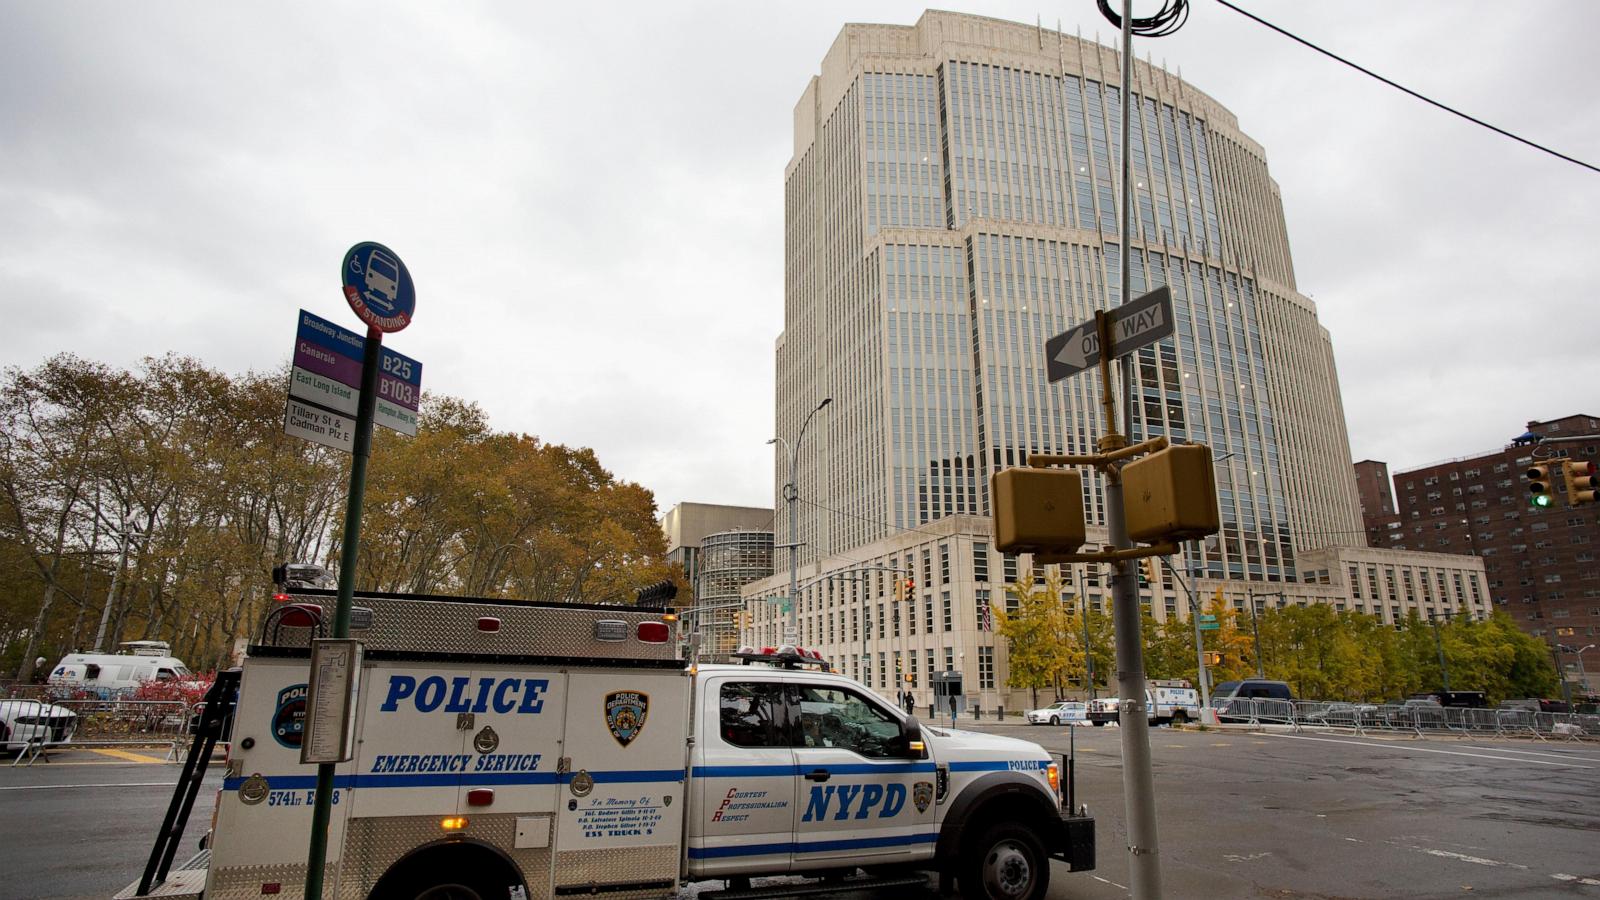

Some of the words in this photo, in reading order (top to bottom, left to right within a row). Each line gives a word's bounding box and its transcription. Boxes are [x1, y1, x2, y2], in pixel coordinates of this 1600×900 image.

[350, 292, 363, 308] NO
[363, 308, 406, 328] STANDING
[303, 315, 337, 339] Broadway
[337, 330, 363, 349] Junction
[1081, 333, 1100, 355] ON
[1121, 305, 1158, 338] WAY
[300, 342, 336, 365] Canarsie
[383, 355, 412, 380] B25
[296, 371, 312, 386] East
[313, 377, 330, 394] Long
[331, 384, 352, 399] Island
[380, 378, 412, 404] B103
[290, 415, 325, 435] Cadman
[328, 427, 342, 440] Plz
[343, 432, 350, 442] E
[291, 404, 319, 423] Tillary
[322, 415, 332, 426] St
[334, 418, 342, 429] &
[281, 687, 309, 705] POLI
[380, 675, 549, 714] POLICE
[607, 699, 647, 710] DEPARTMENT
[615, 693, 640, 701] POLICE
[370, 755, 473, 773] EMERGENCY
[474, 754, 542, 772] SERVICE
[1008, 760, 1038, 770] POLICE
[591, 798, 602, 806] In
[606, 798, 637, 807] Memory
[719, 799, 788, 810] PROFESSIONALISM
[727, 788, 768, 799] COURTESY
[801, 783, 907, 822] NYPD
[712, 811, 750, 822] RESPECT
